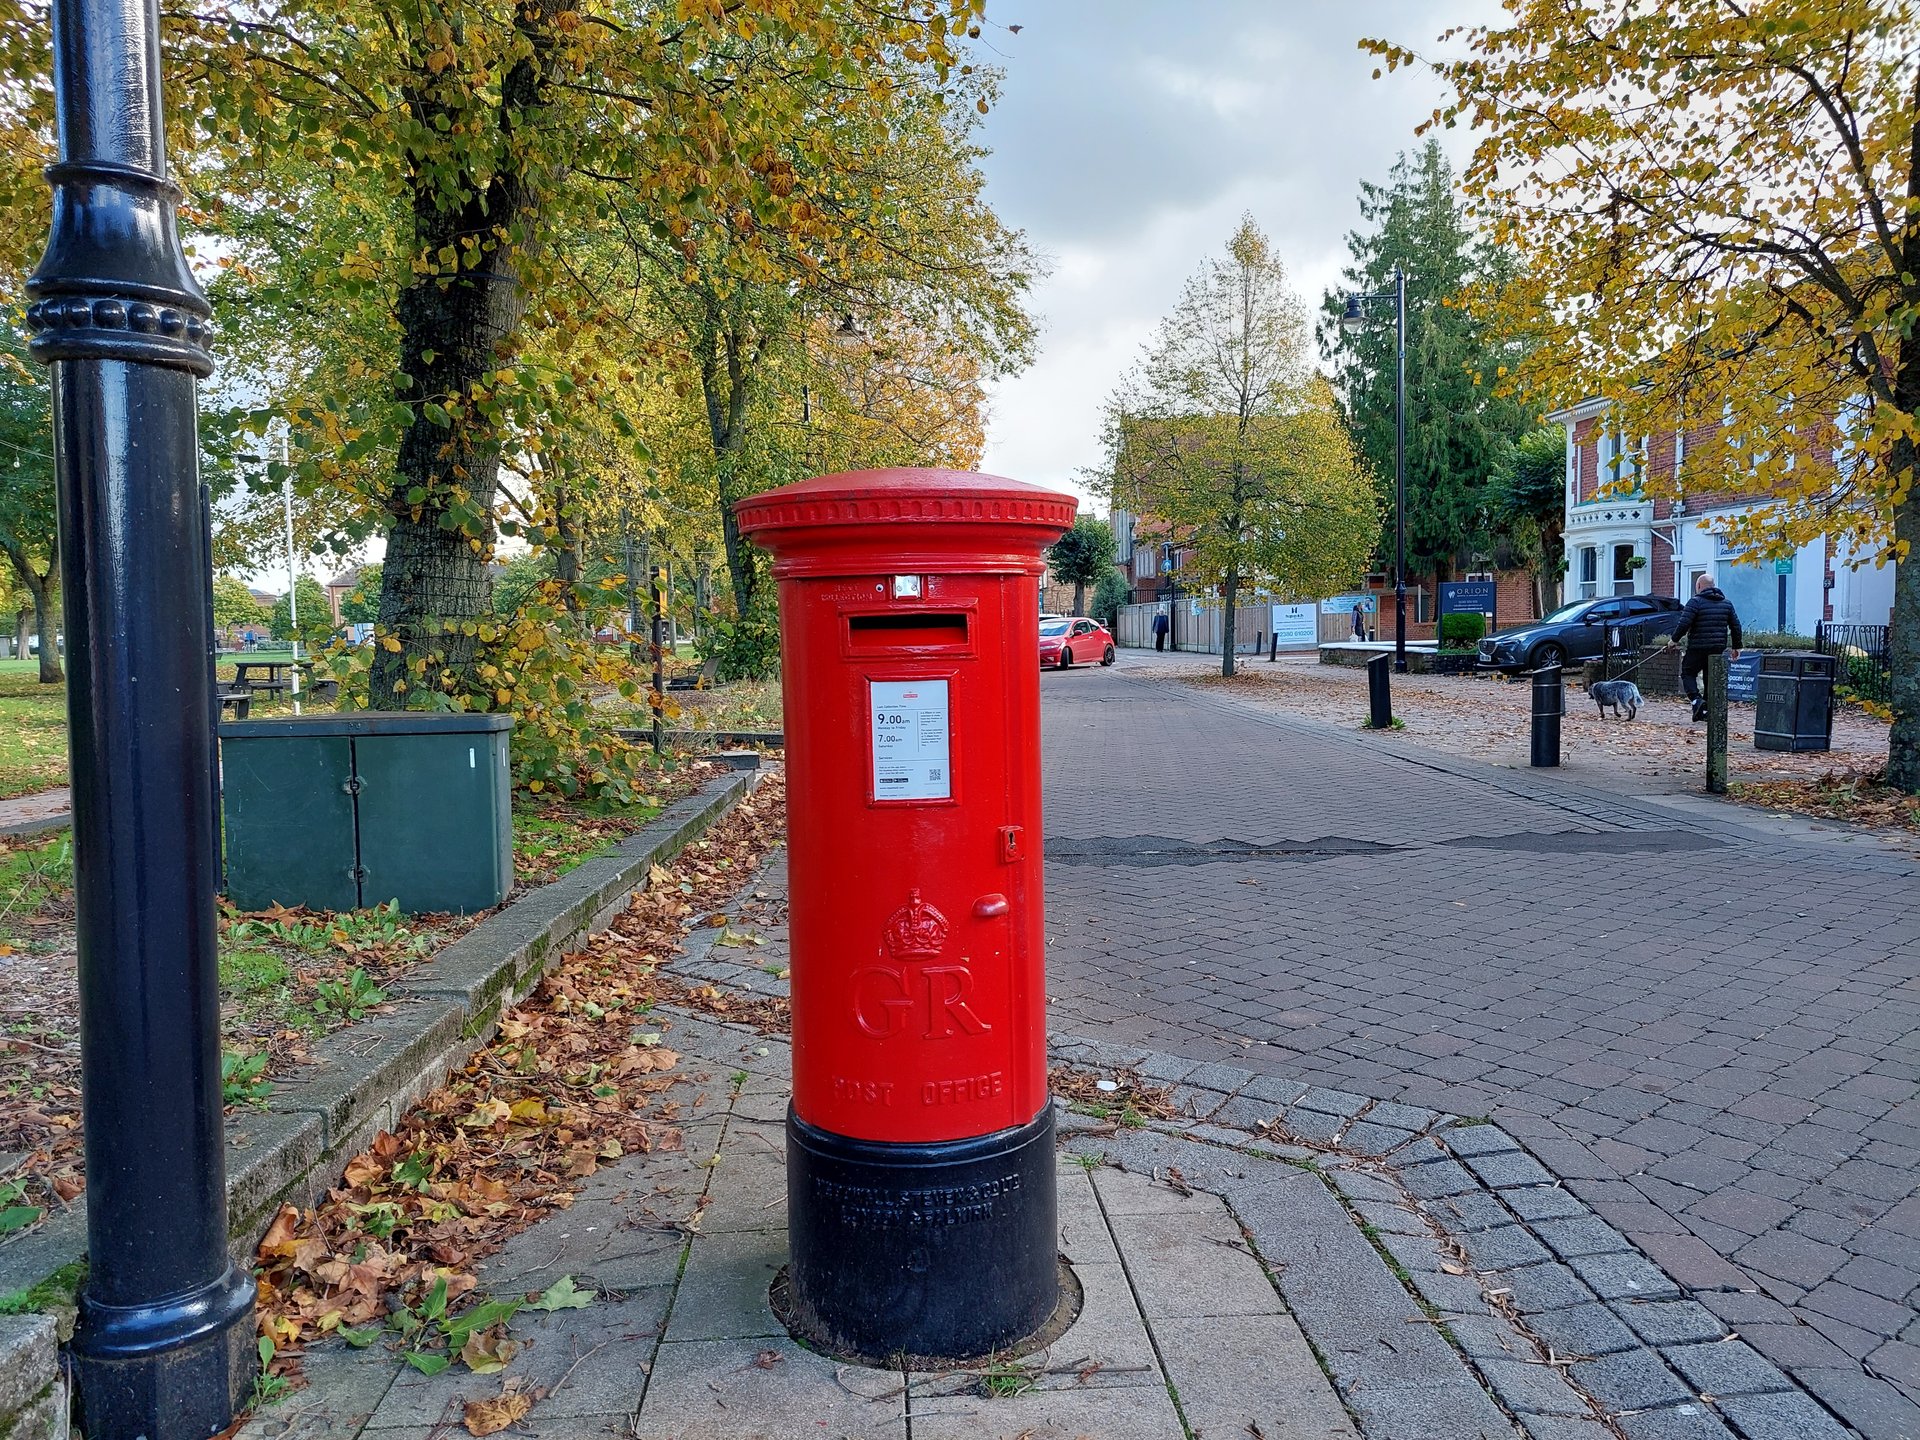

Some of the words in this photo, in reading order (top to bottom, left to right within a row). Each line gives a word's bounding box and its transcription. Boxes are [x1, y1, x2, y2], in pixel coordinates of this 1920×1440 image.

[1456, 587, 1489, 595] ORION
[849, 964, 993, 1040] GR
[832, 1075, 895, 1107] POST
[920, 1071, 1003, 1107] OFFICE
